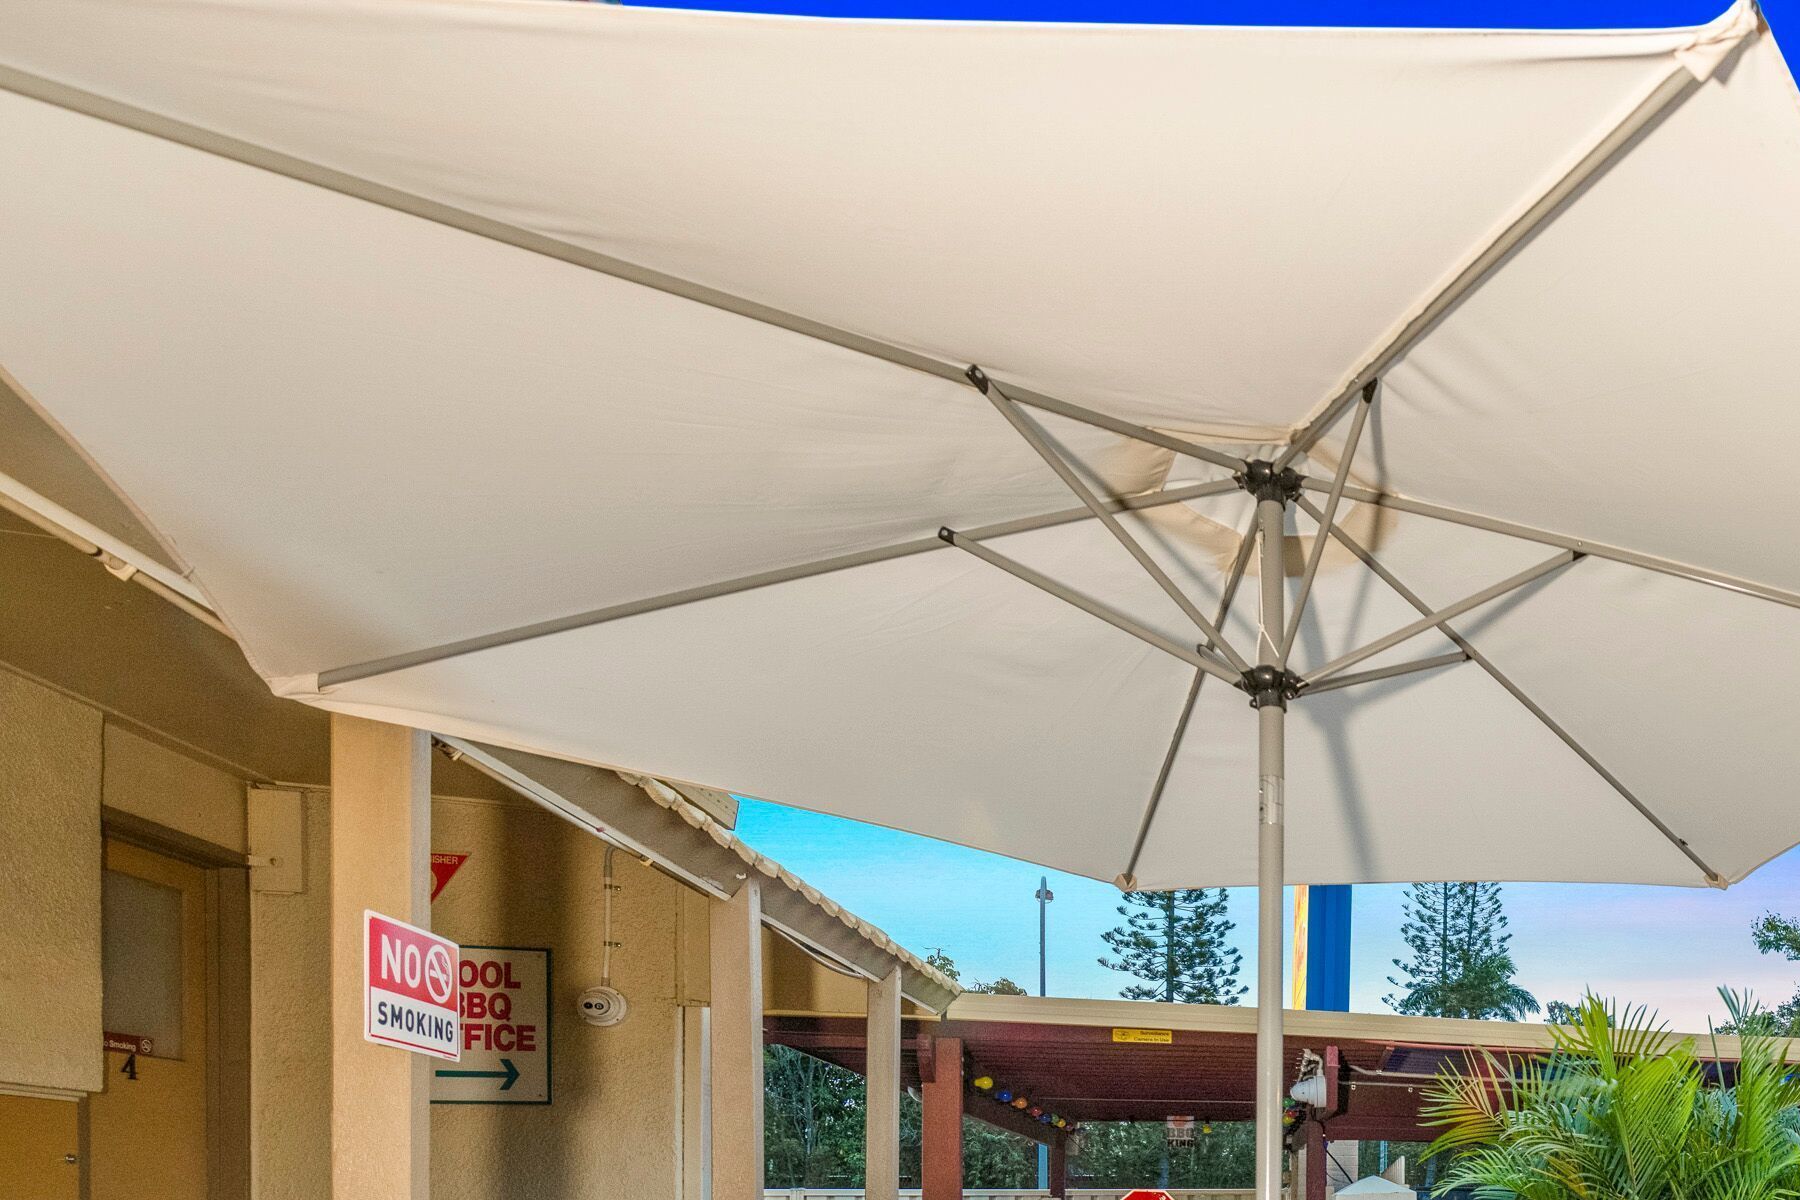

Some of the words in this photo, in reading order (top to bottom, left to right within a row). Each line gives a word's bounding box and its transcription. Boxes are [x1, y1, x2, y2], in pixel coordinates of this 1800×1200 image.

[432, 855, 459, 865] ISHER
[381, 933, 422, 989] NO
[459, 959, 522, 990] OOL
[459, 991, 512, 1022] BQ
[377, 1001, 454, 1044] SMOKING
[109, 1040, 137, 1053] Smoking
[460, 1023, 537, 1052] FICE
[120, 1053, 138, 1081] 4
[1167, 1139, 1195, 1148] KING
